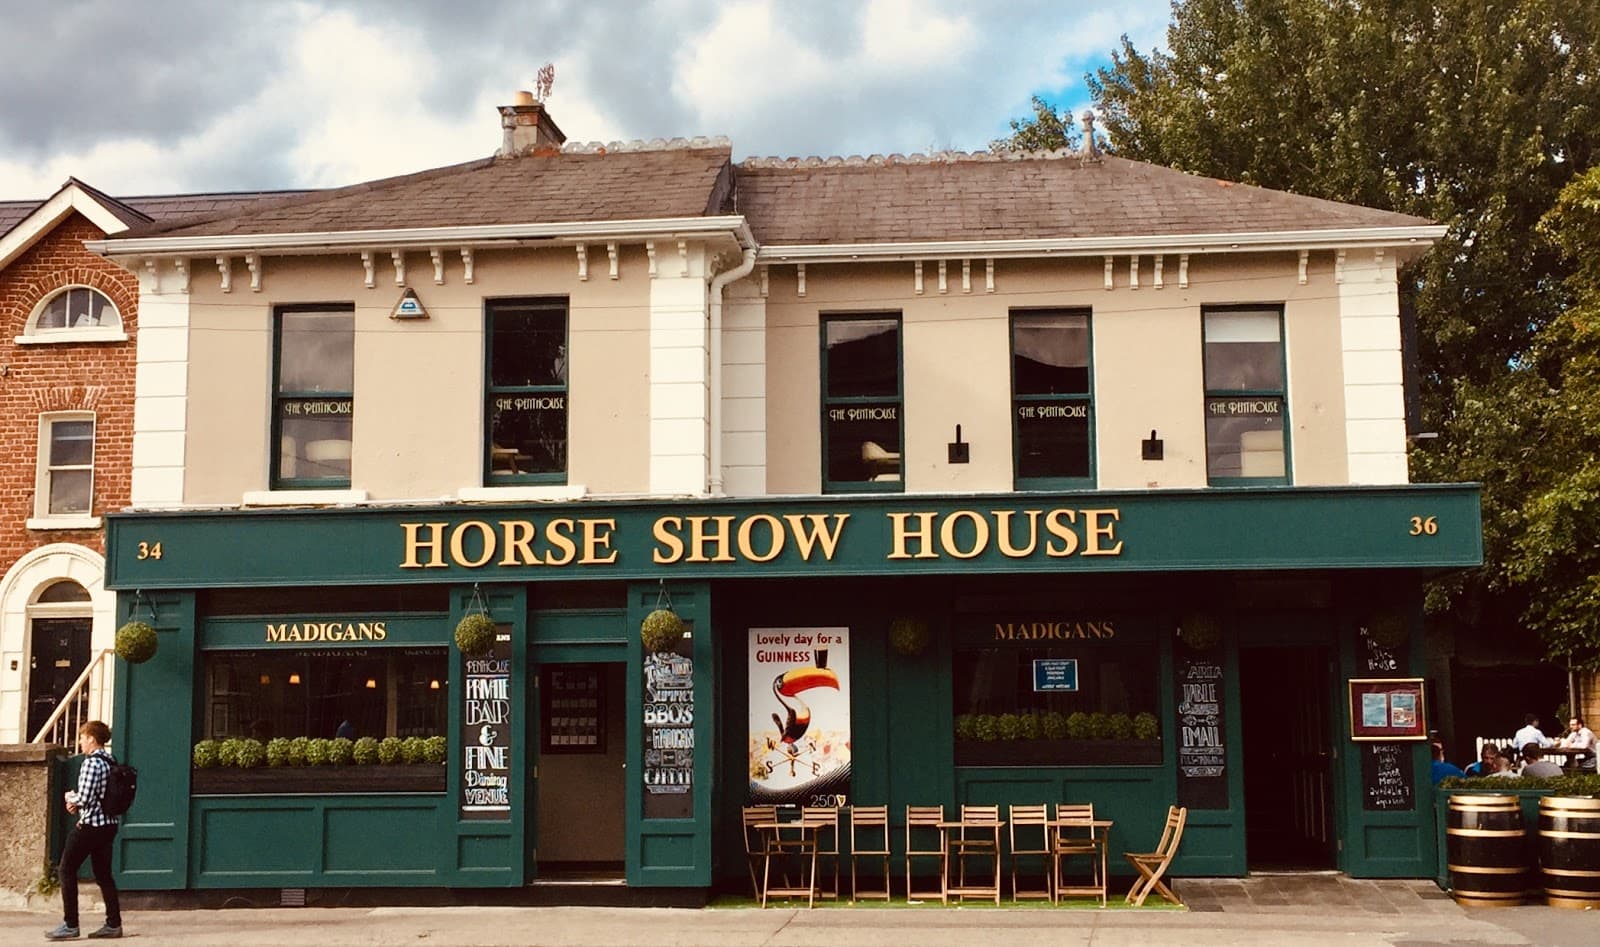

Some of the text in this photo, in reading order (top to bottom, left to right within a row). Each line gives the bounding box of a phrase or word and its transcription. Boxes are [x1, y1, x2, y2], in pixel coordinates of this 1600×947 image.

[285, 402, 352, 415] THE PENTHOUSE
[496, 397, 564, 411] THE PENTHOUSE
[1018, 405, 1086, 419] THE PENTHOUSE
[1209, 401, 1278, 414] THE PENTHOUSE
[829, 408, 896, 421] THE PENTHOUSE
[1409, 516, 1438, 536] 36
[399, 508, 1124, 568] HORSE SHOW HOUSE
[136, 541, 162, 560] 34
[265, 622, 386, 642] MADIGANS
[757, 632, 842, 647] Lovely day for a
[993, 621, 1115, 640] MADIGANS
[756, 650, 811, 663] GUINNESS
[466, 679, 510, 700] PRIVATE
[1182, 683, 1217, 703] TABLE
[466, 700, 510, 725] BAR
[479, 725, 498, 746] &
[1182, 726, 1224, 747] EMAIL
[465, 746, 509, 770] FINE
[765, 760, 774, 774] S
[811, 761, 821, 776] E
[465, 769, 508, 790] Dining
[465, 788, 509, 805] VENUE
[810, 794, 837, 808] 250
